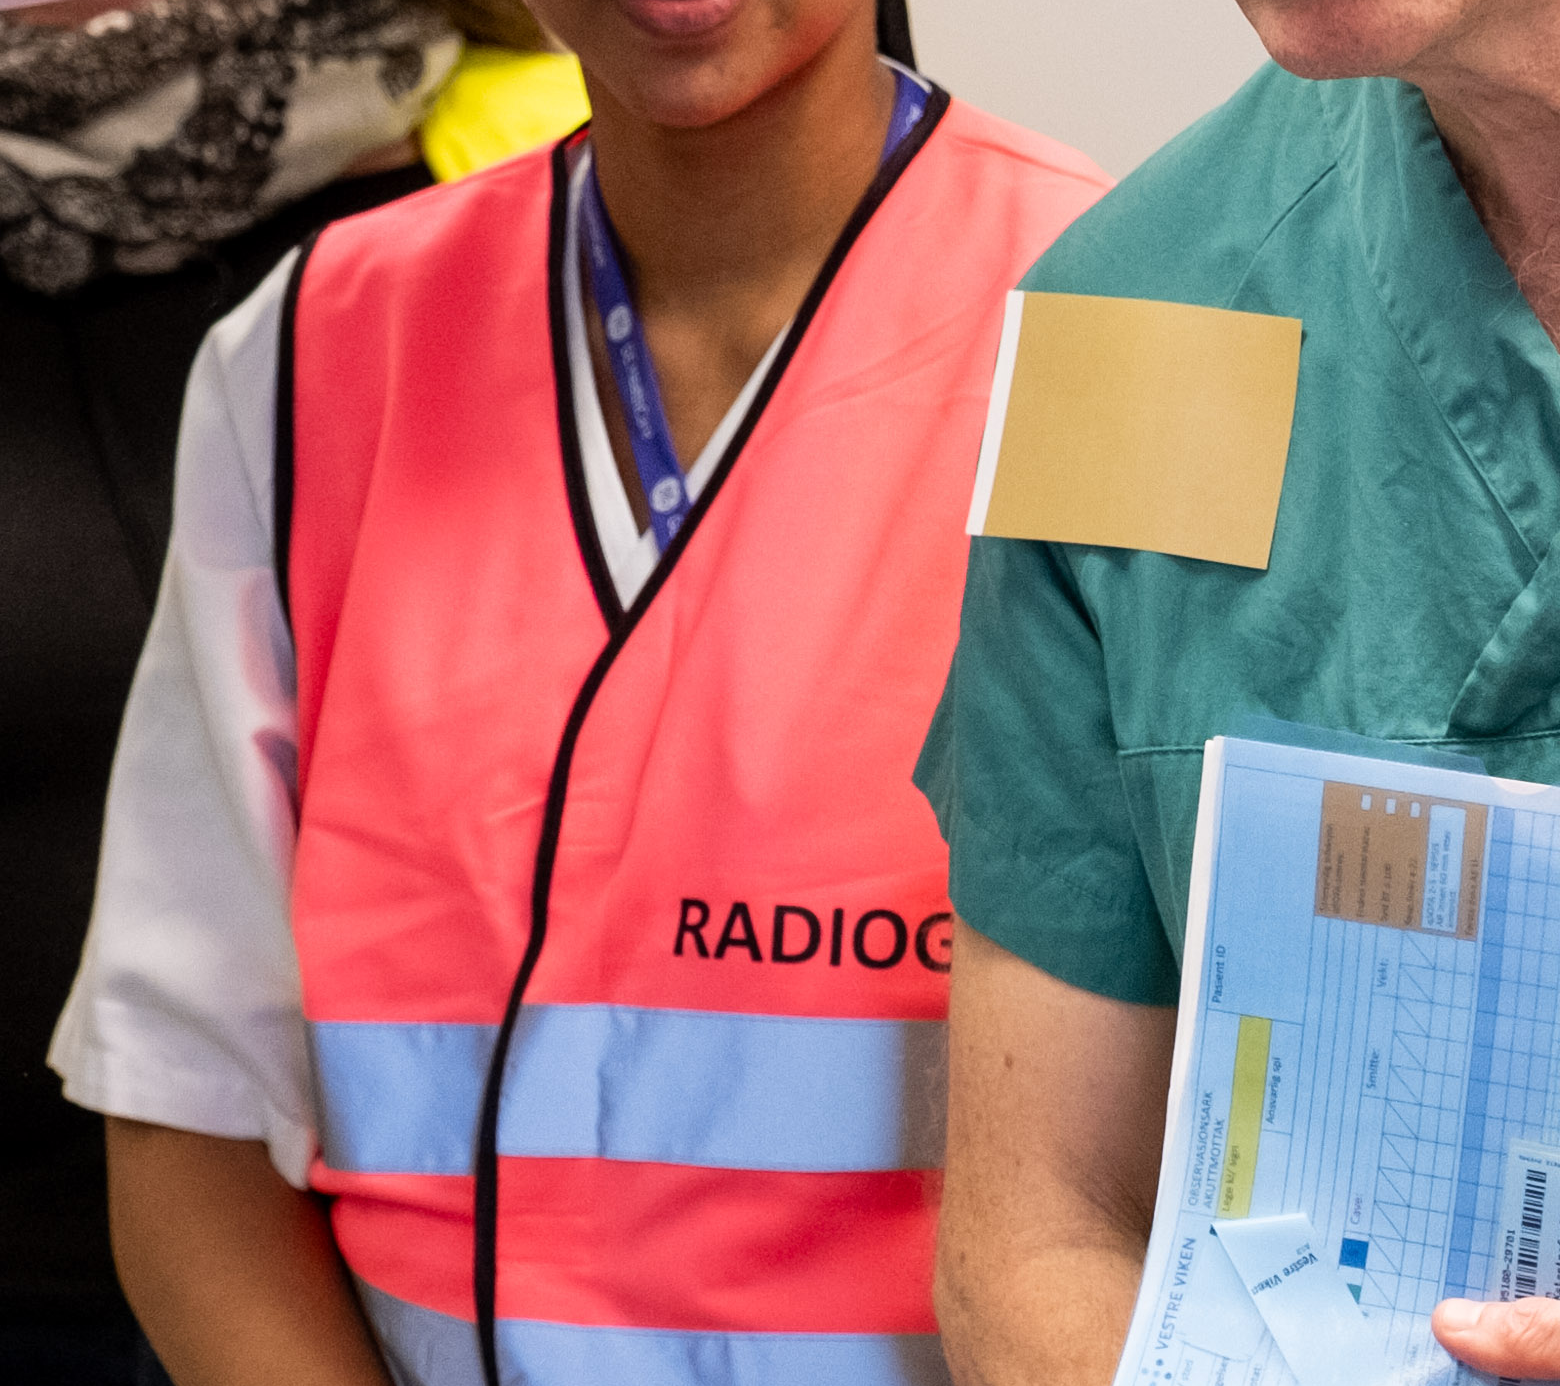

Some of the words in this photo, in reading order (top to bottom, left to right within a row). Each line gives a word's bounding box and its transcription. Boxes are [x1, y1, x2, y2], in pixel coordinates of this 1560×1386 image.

[673, 898, 954, 973] RADIOG
[1216, 946, 1225, 959] ID
[1212, 962, 1226, 1003] Pasient
[1377, 958, 1389, 987] Vekt:
[1366, 1052, 1379, 1089] Smitte:
[1265, 1079, 1281, 1123] Ansvarlig
[1188, 1092, 1213, 1207] OBSERVASJONSARK
[1203, 1120, 1225, 1209] AKUTTMOTTAK
[1350, 1194, 1362, 1224] Cave:
[1284, 1251, 1317, 1276] Vestre
[1156, 1291, 1182, 1350] VESTRE
[1175, 1237, 1196, 1287] VIKEN
[1249, 1272, 1282, 1295] Viken
